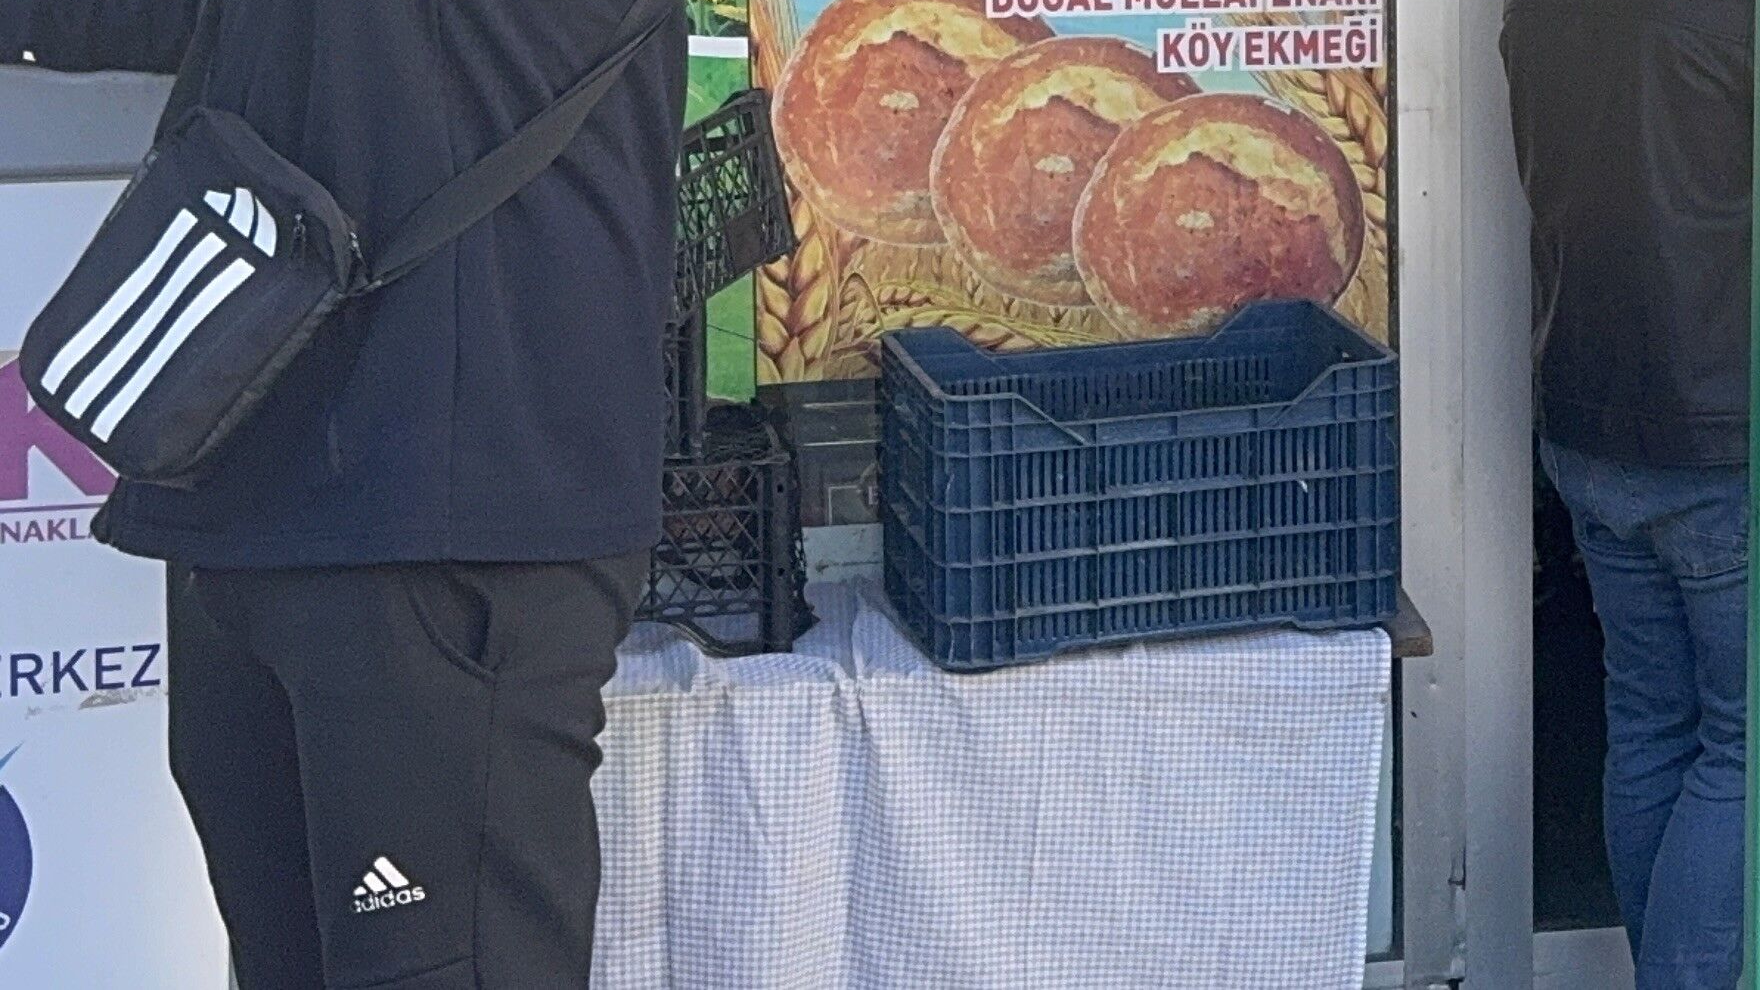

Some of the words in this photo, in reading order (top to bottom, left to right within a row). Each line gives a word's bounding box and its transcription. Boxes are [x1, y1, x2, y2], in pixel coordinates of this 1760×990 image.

[1163, 23, 1234, 68] KÖY
[1245, 18, 1377, 66] EKMEĞİ
[0, 517, 94, 544] NAKL
[0, 643, 161, 697] RKEZ
